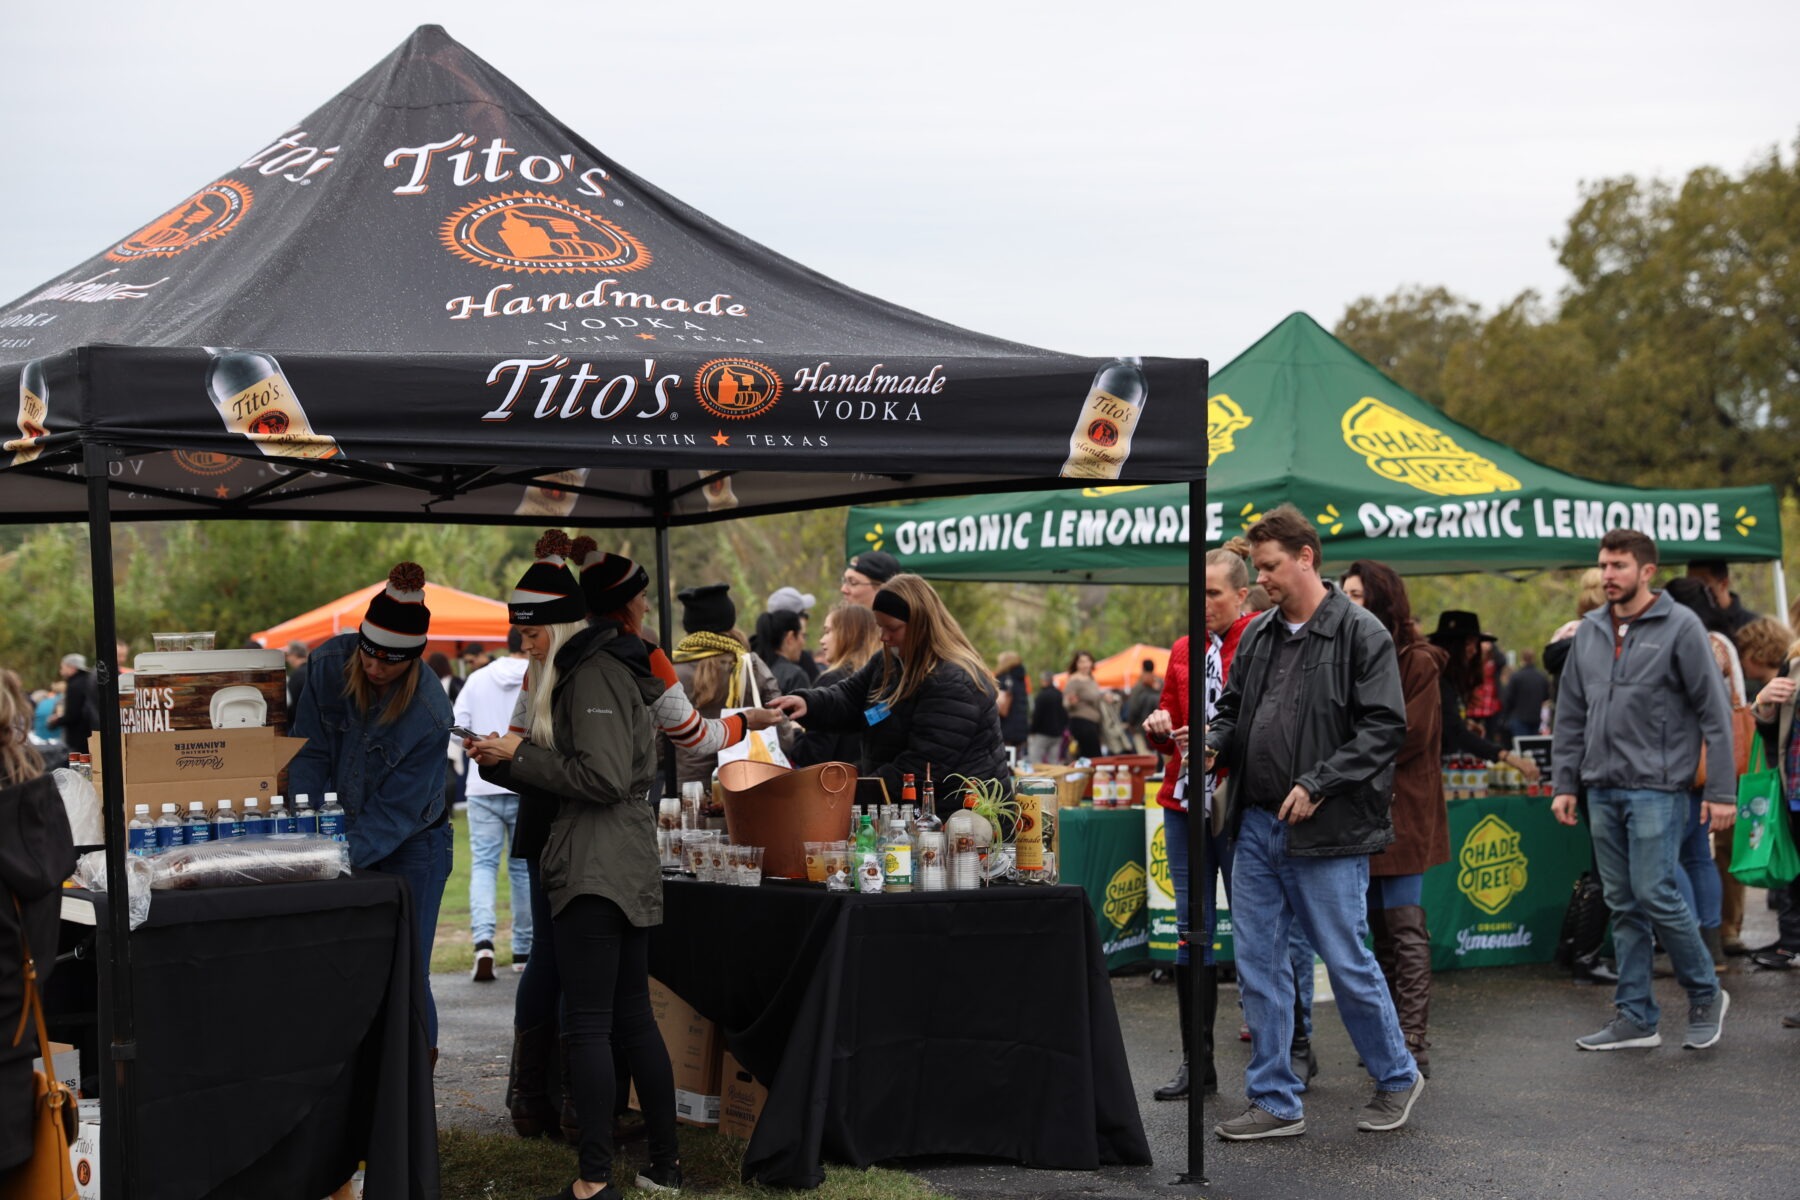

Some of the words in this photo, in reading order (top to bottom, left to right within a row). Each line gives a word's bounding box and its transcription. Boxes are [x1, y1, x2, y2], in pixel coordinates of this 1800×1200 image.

[383, 132, 610, 197] Tito's
[471, 199, 514, 220] AWARD
[523, 197, 592, 222] WINNING
[496, 257, 573, 268] DISTILLED
[446, 279, 748, 320] Handmade
[544, 316, 707, 332] VODKA
[527, 334, 620, 346] AUSTIN
[673, 334, 765, 344] TEXAS
[480, 354, 681, 422] Tito's
[793, 362, 947, 396] Handmade
[232, 382, 280, 421] Tito's
[813, 400, 924, 422] VODKA
[1092, 396, 1132, 424] Tito's
[610, 434, 696, 447] AUSTIN
[747, 434, 830, 448] TEXAS
[895, 512, 1032, 555] ORGANIC
[1358, 499, 1524, 540] ORGANIC
[1533, 499, 1722, 541] LEMONADE
[174, 741, 226, 751] RAINWATER
[1462, 835, 1518, 868] SHADE
[1455, 924, 1532, 955] Lemonade
